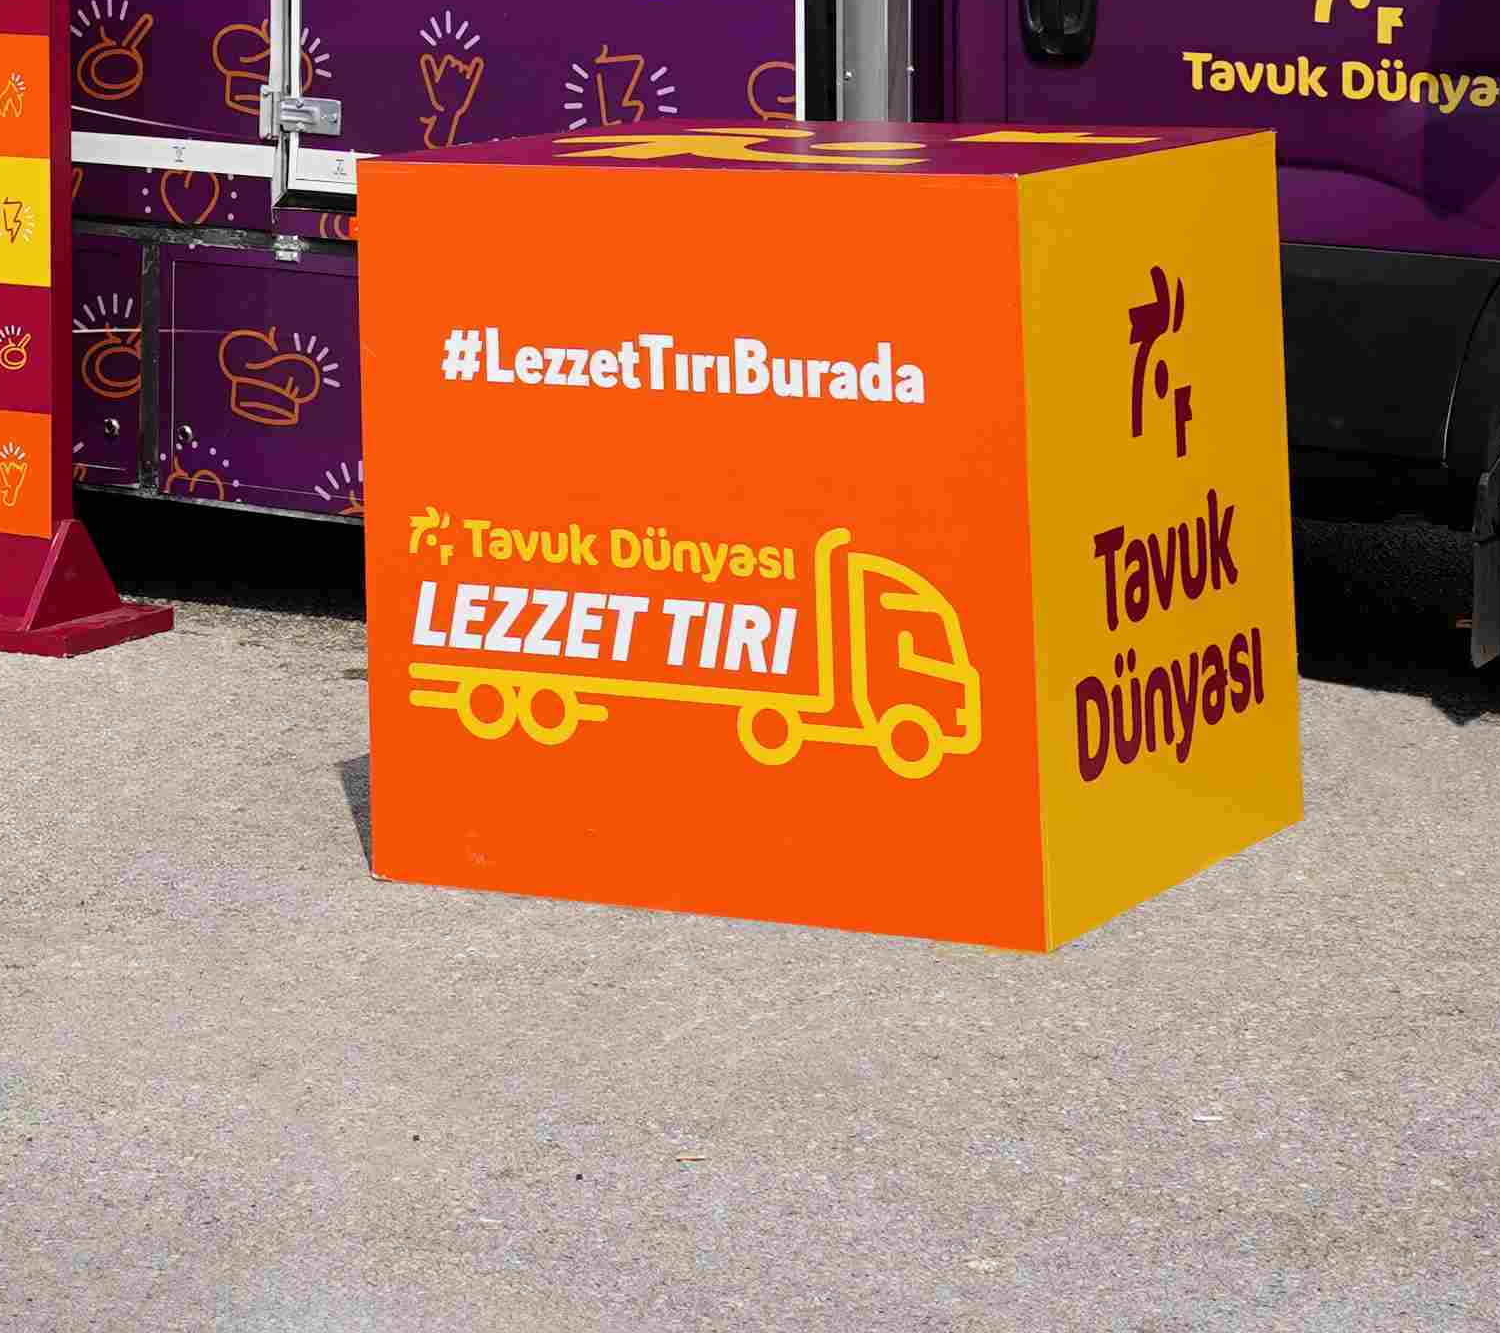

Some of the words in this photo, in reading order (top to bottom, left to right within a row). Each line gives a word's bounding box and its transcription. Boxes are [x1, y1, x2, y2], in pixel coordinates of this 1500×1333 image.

[1182, 51, 1327, 99] Tavuk
[441, 327, 926, 405] #LezzetTırıBurada
[463, 519, 599, 567] Tavuk
[609, 526, 796, 584] Dünyası
[1093, 488, 1239, 633] Tavuk
[412, 580, 651, 663] LEZZET
[662, 599, 798, 676] TIRI
[1075, 626, 1265, 783] Dünyası
